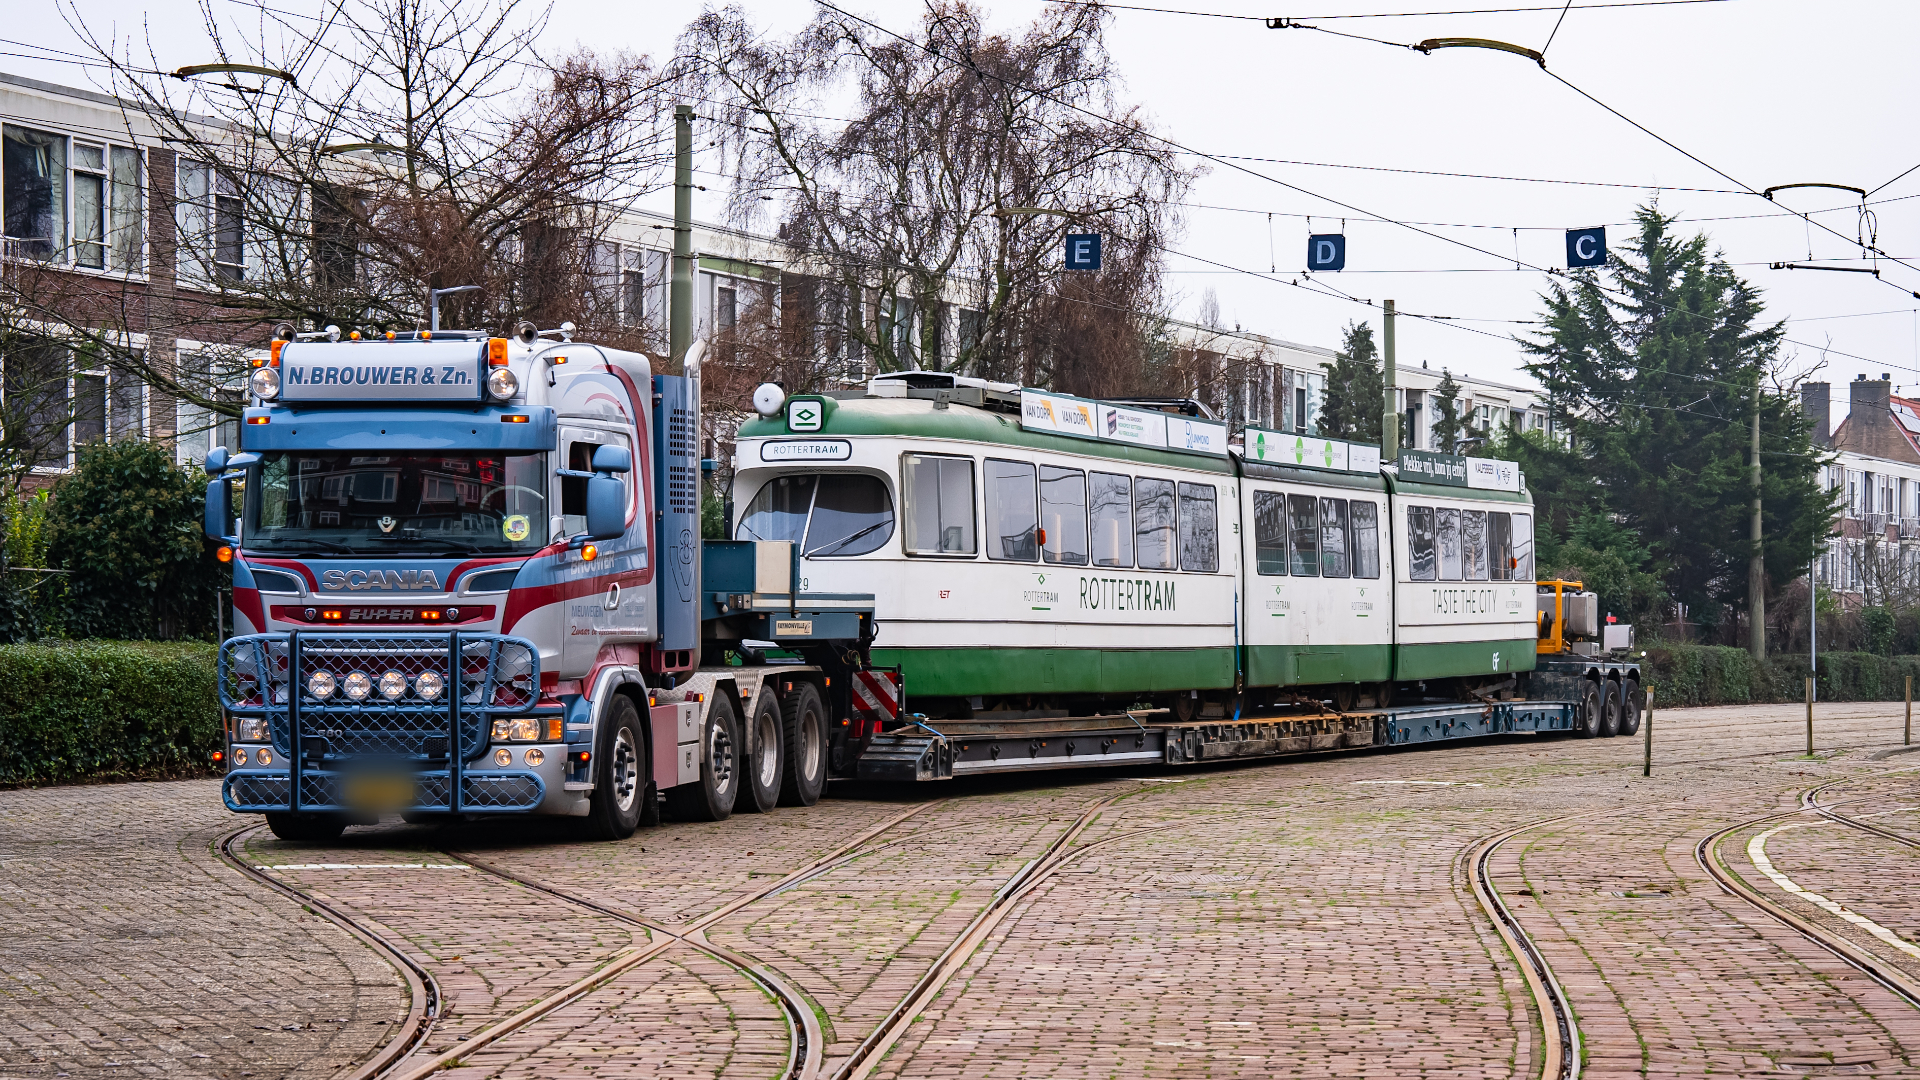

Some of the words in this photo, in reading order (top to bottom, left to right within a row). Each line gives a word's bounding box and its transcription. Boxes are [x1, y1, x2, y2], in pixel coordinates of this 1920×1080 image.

[1075, 241, 1091, 263] E
[1316, 241, 1336, 264] D
[1575, 235, 1597, 260] C
[288, 366, 418, 386] N.BROUWER
[420, 366, 437, 386] &
[439, 366, 474, 386] Zn.
[1025, 404, 1036, 418] VAN
[1036, 406, 1051, 420] DORP
[1062, 411, 1073, 424] VAN
[1073, 412, 1088, 426] DORP
[773, 445, 838, 454] ROTTERTRAM
[1403, 455, 1422, 472] Plekkie
[322, 570, 440, 590] SCANIA
[1024, 591, 1059, 603] ROTTERTRAM
[1080, 577, 1176, 611] ROTTERTRAM
[1433, 589, 1457, 614] TASTE
[1461, 589, 1476, 614] THE
[1480, 589, 1497, 614] CITY
[1266, 601, 1290, 610] ROTTERTRAM
[1351, 602, 1373, 611] ROTTERTRAM
[349, 609, 414, 620] SUPER
